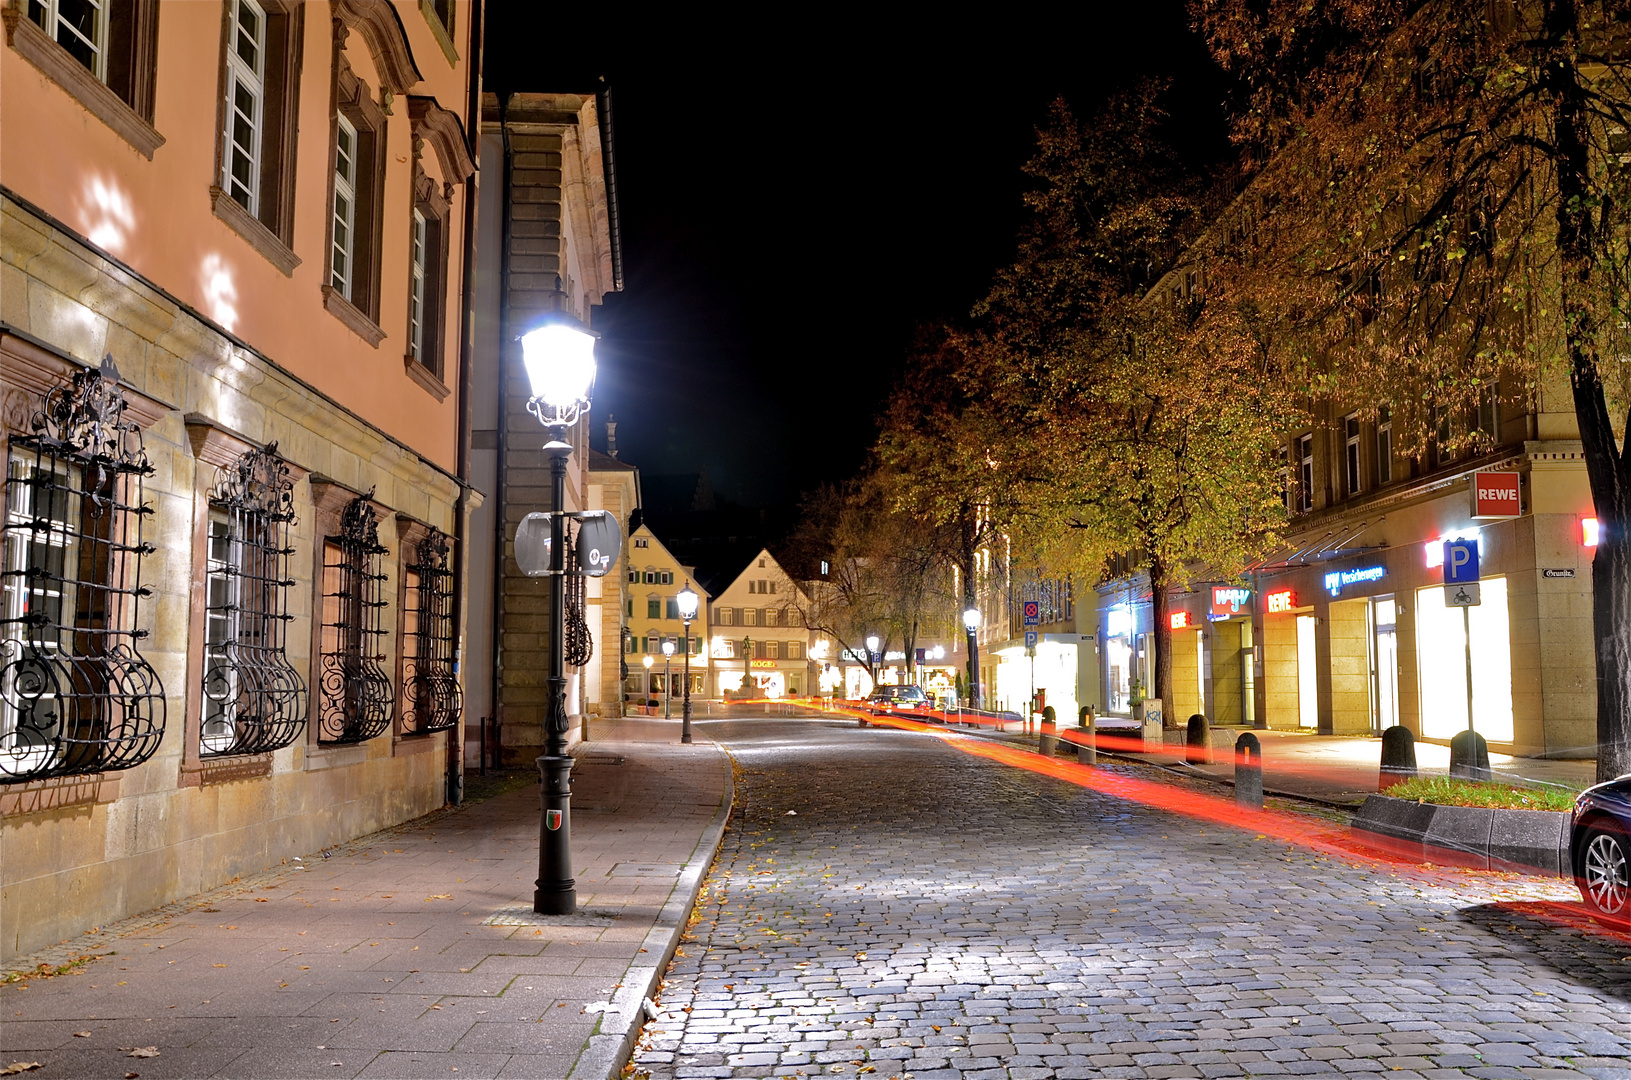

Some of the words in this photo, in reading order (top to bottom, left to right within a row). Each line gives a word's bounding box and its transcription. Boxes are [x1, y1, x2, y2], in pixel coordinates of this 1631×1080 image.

[1479, 489, 1517, 500] REWE
[1451, 546, 1470, 578] P
[1268, 591, 1291, 613] REWE
[1028, 633, 1036, 647] P
